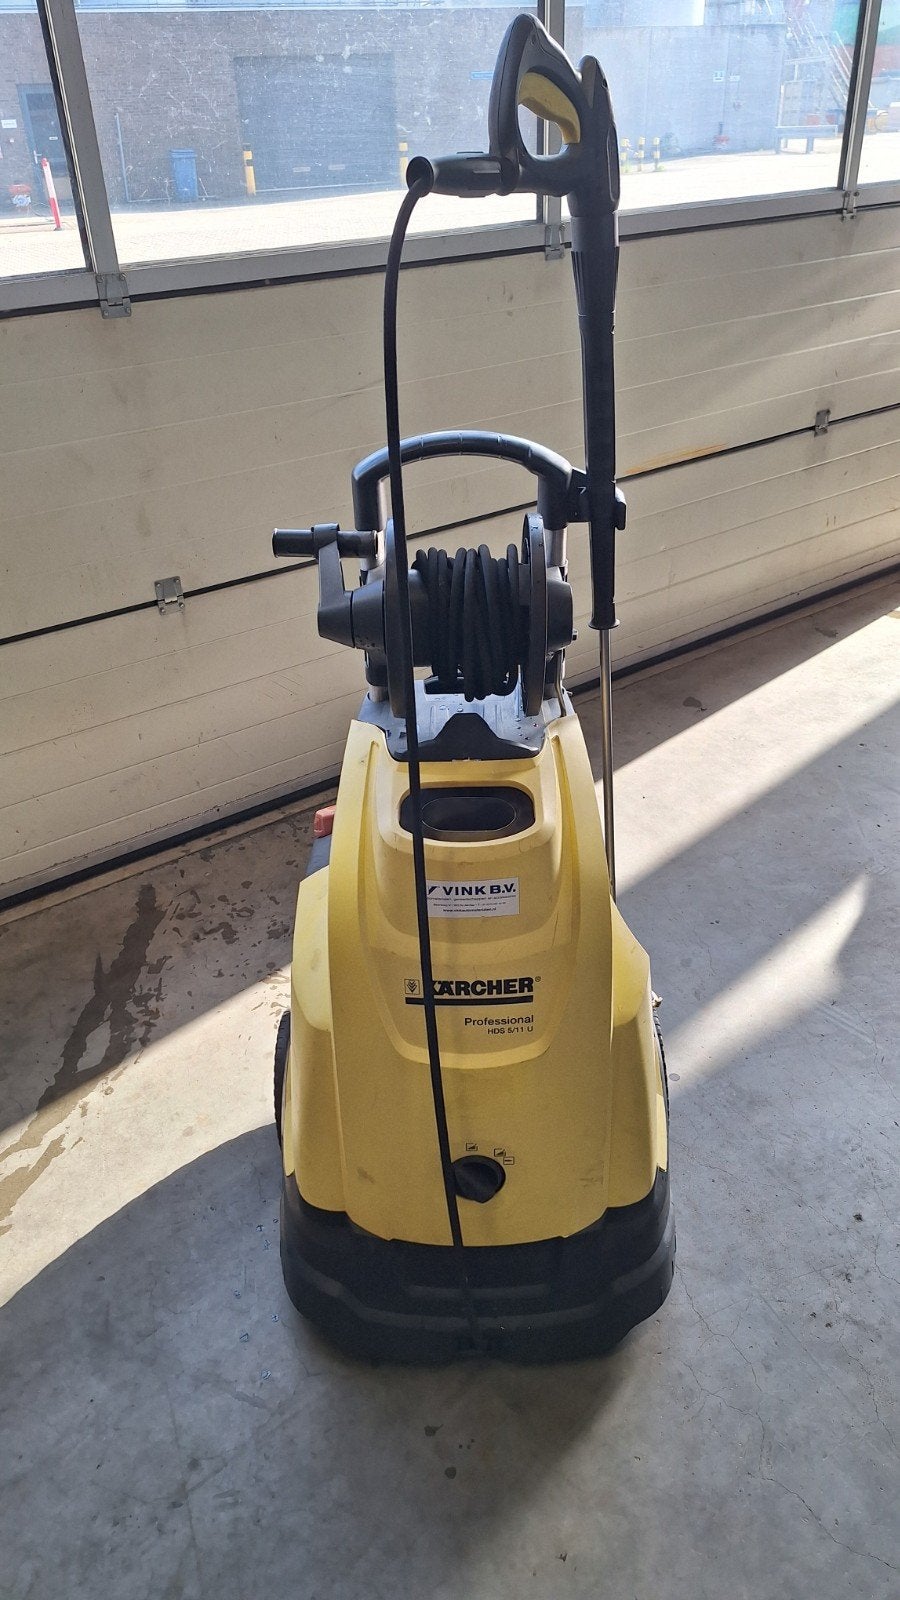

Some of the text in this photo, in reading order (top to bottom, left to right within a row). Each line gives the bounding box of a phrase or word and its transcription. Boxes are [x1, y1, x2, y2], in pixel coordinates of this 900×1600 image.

[443, 882, 516, 896] VINK B.V.
[464, 1014, 534, 1027] Professional
[487, 1025, 534, 1035] HDS 5/11 U
